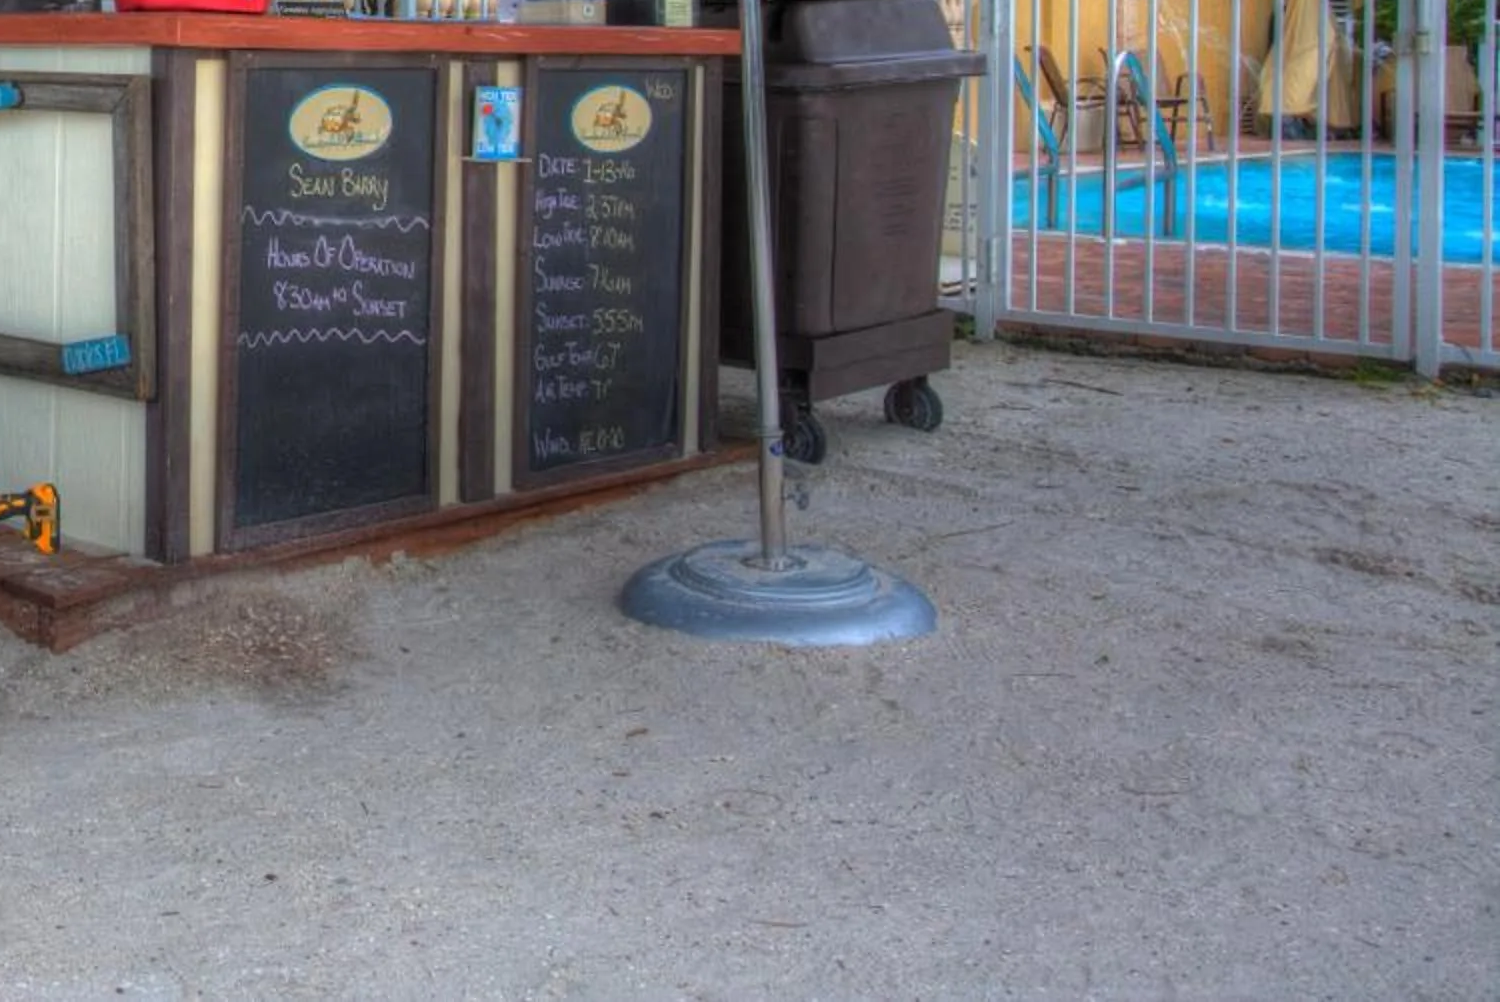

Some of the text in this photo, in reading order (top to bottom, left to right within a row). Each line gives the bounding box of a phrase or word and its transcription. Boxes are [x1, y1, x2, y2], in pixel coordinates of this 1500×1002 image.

[288, 162, 390, 212] SEAN BARRY
[267, 233, 416, 279] HOURS OF OPERATION
[351, 279, 408, 319] SUNSET
